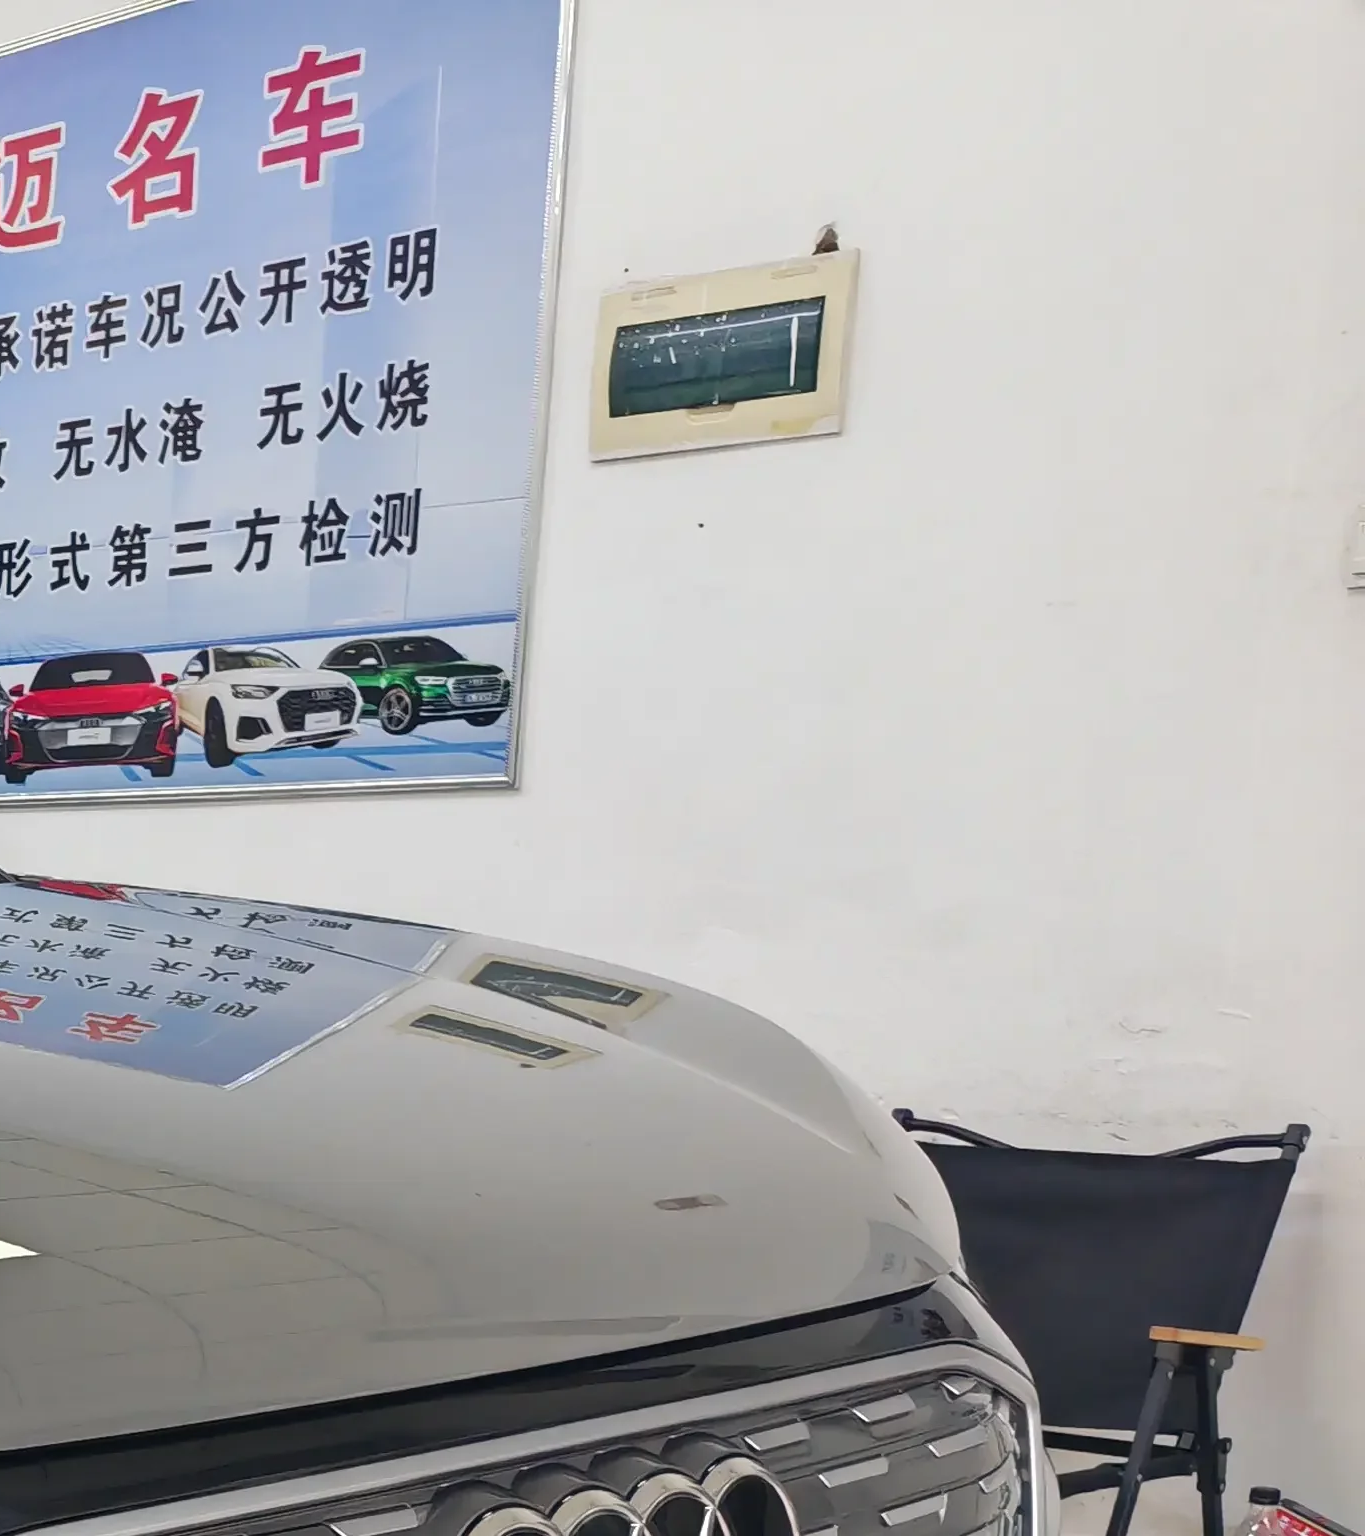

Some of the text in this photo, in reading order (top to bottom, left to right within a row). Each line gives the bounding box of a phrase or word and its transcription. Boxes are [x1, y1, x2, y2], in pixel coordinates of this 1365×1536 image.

[53, 398, 204, 481] 无水淹
[256, 359, 430, 450] 无火烧
